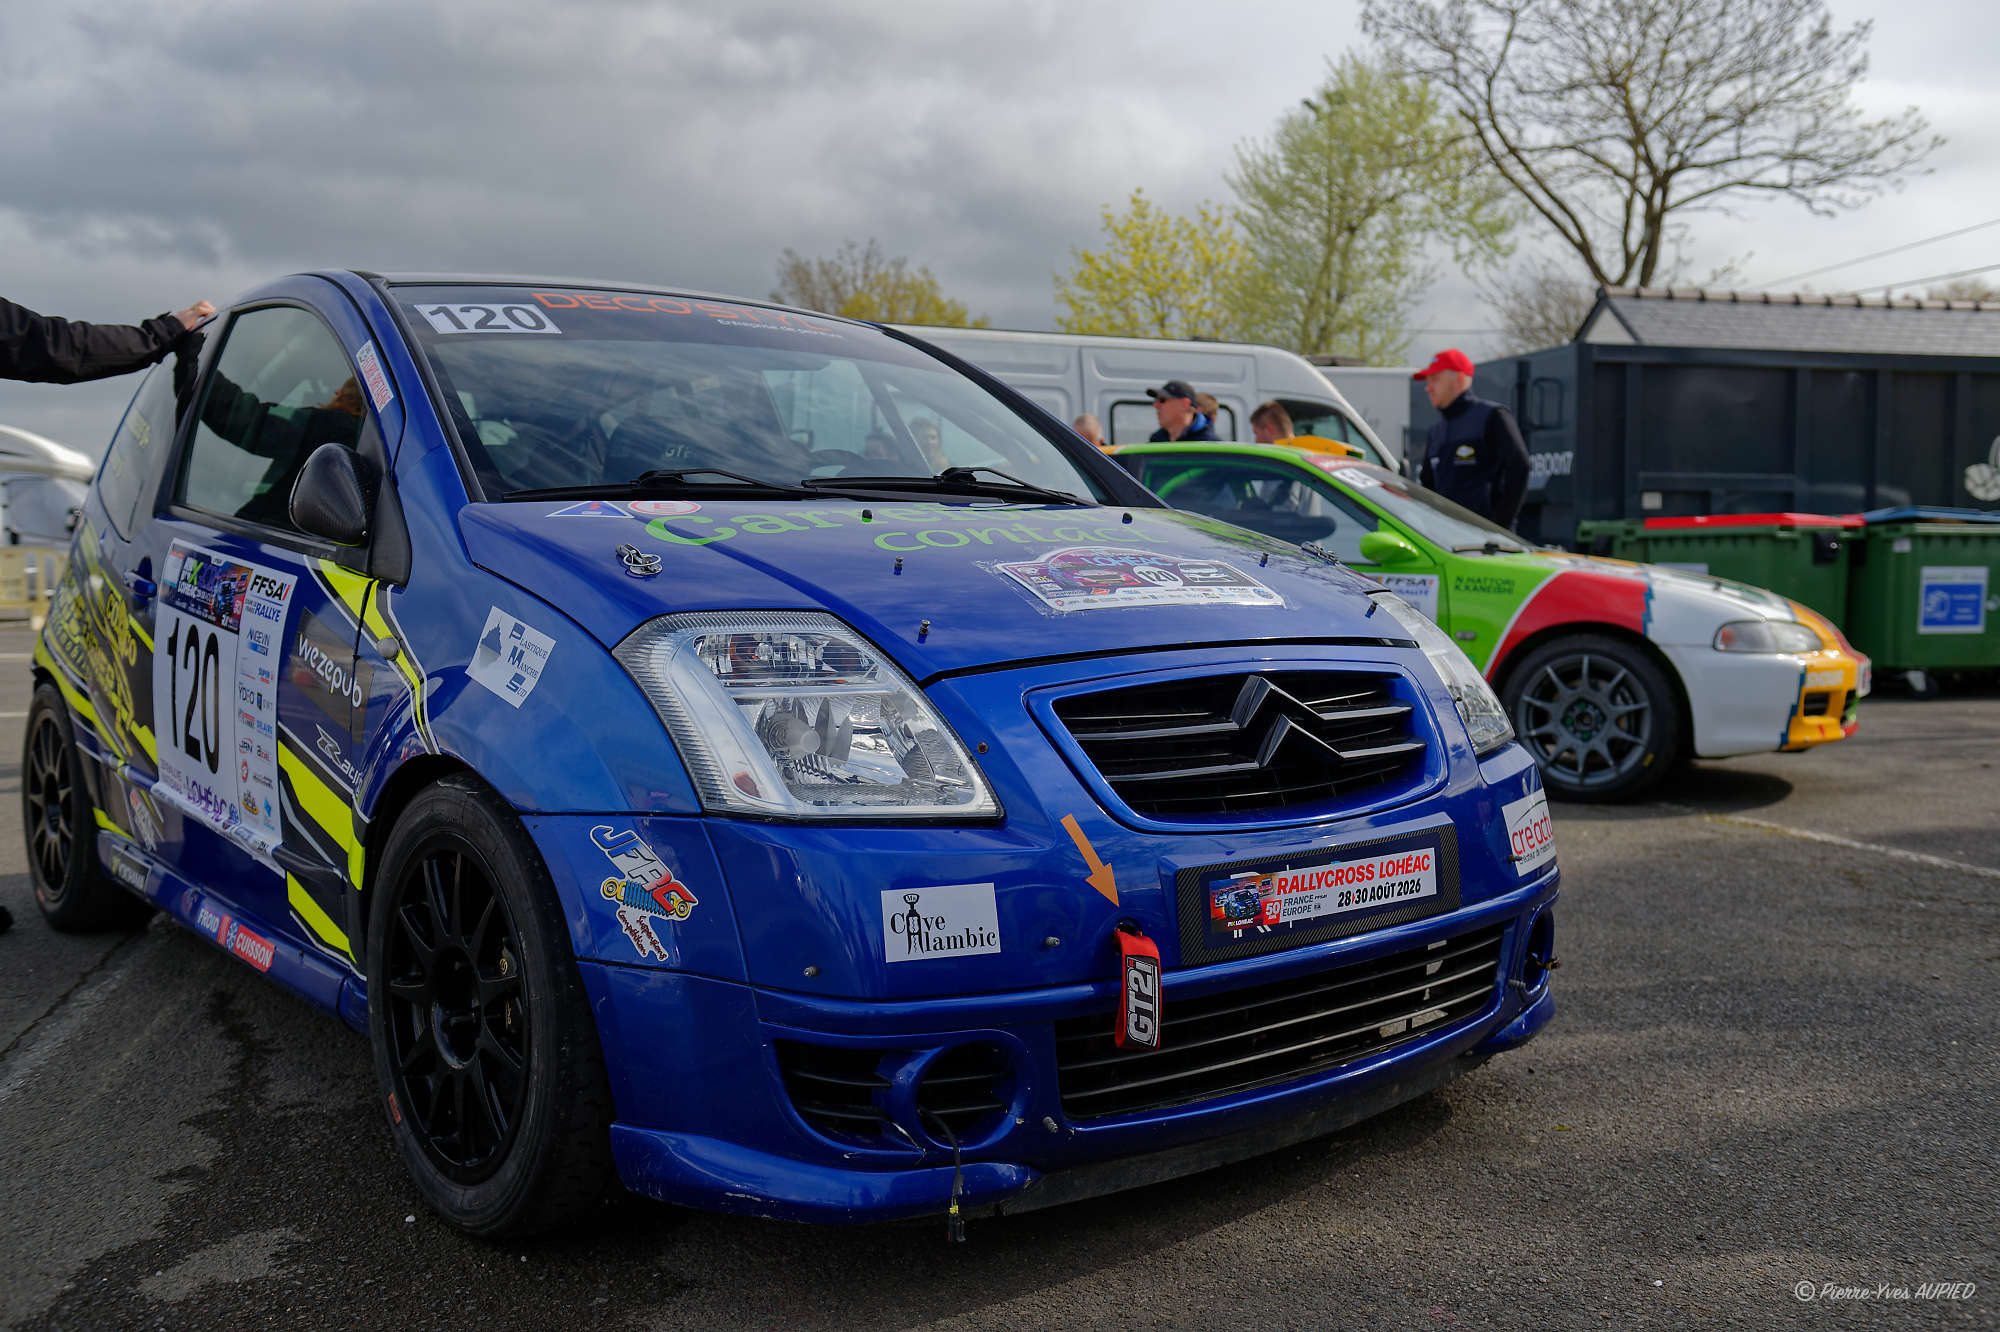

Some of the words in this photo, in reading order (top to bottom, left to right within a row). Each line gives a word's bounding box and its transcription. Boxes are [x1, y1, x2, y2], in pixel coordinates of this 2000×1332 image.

[428, 305, 547, 331] 120
[874, 523, 1168, 551] contact
[250, 574, 283, 601] FFSA
[1137, 569, 1179, 583] 120
[255, 603, 282, 623] RALLYE
[298, 634, 363, 709] wezepub
[507, 645, 539, 679] MANCHE
[167, 617, 219, 775] 120
[505, 672, 528, 697] SUD
[1277, 863, 1375, 896] RALLYCROSS
[1379, 854, 1431, 879] LOHÉAC
[1283, 894, 1314, 907] FRANCE
[1369, 882, 1396, 901] AOÛT
[1397, 878, 1421, 896] 2026
[197, 907, 221, 934] FROID
[1265, 901, 1281, 916] 50
[1282, 905, 1312, 917] EUROPE
[235, 931, 274, 968] CUISSON
[1128, 958, 1153, 1042] GT2i
